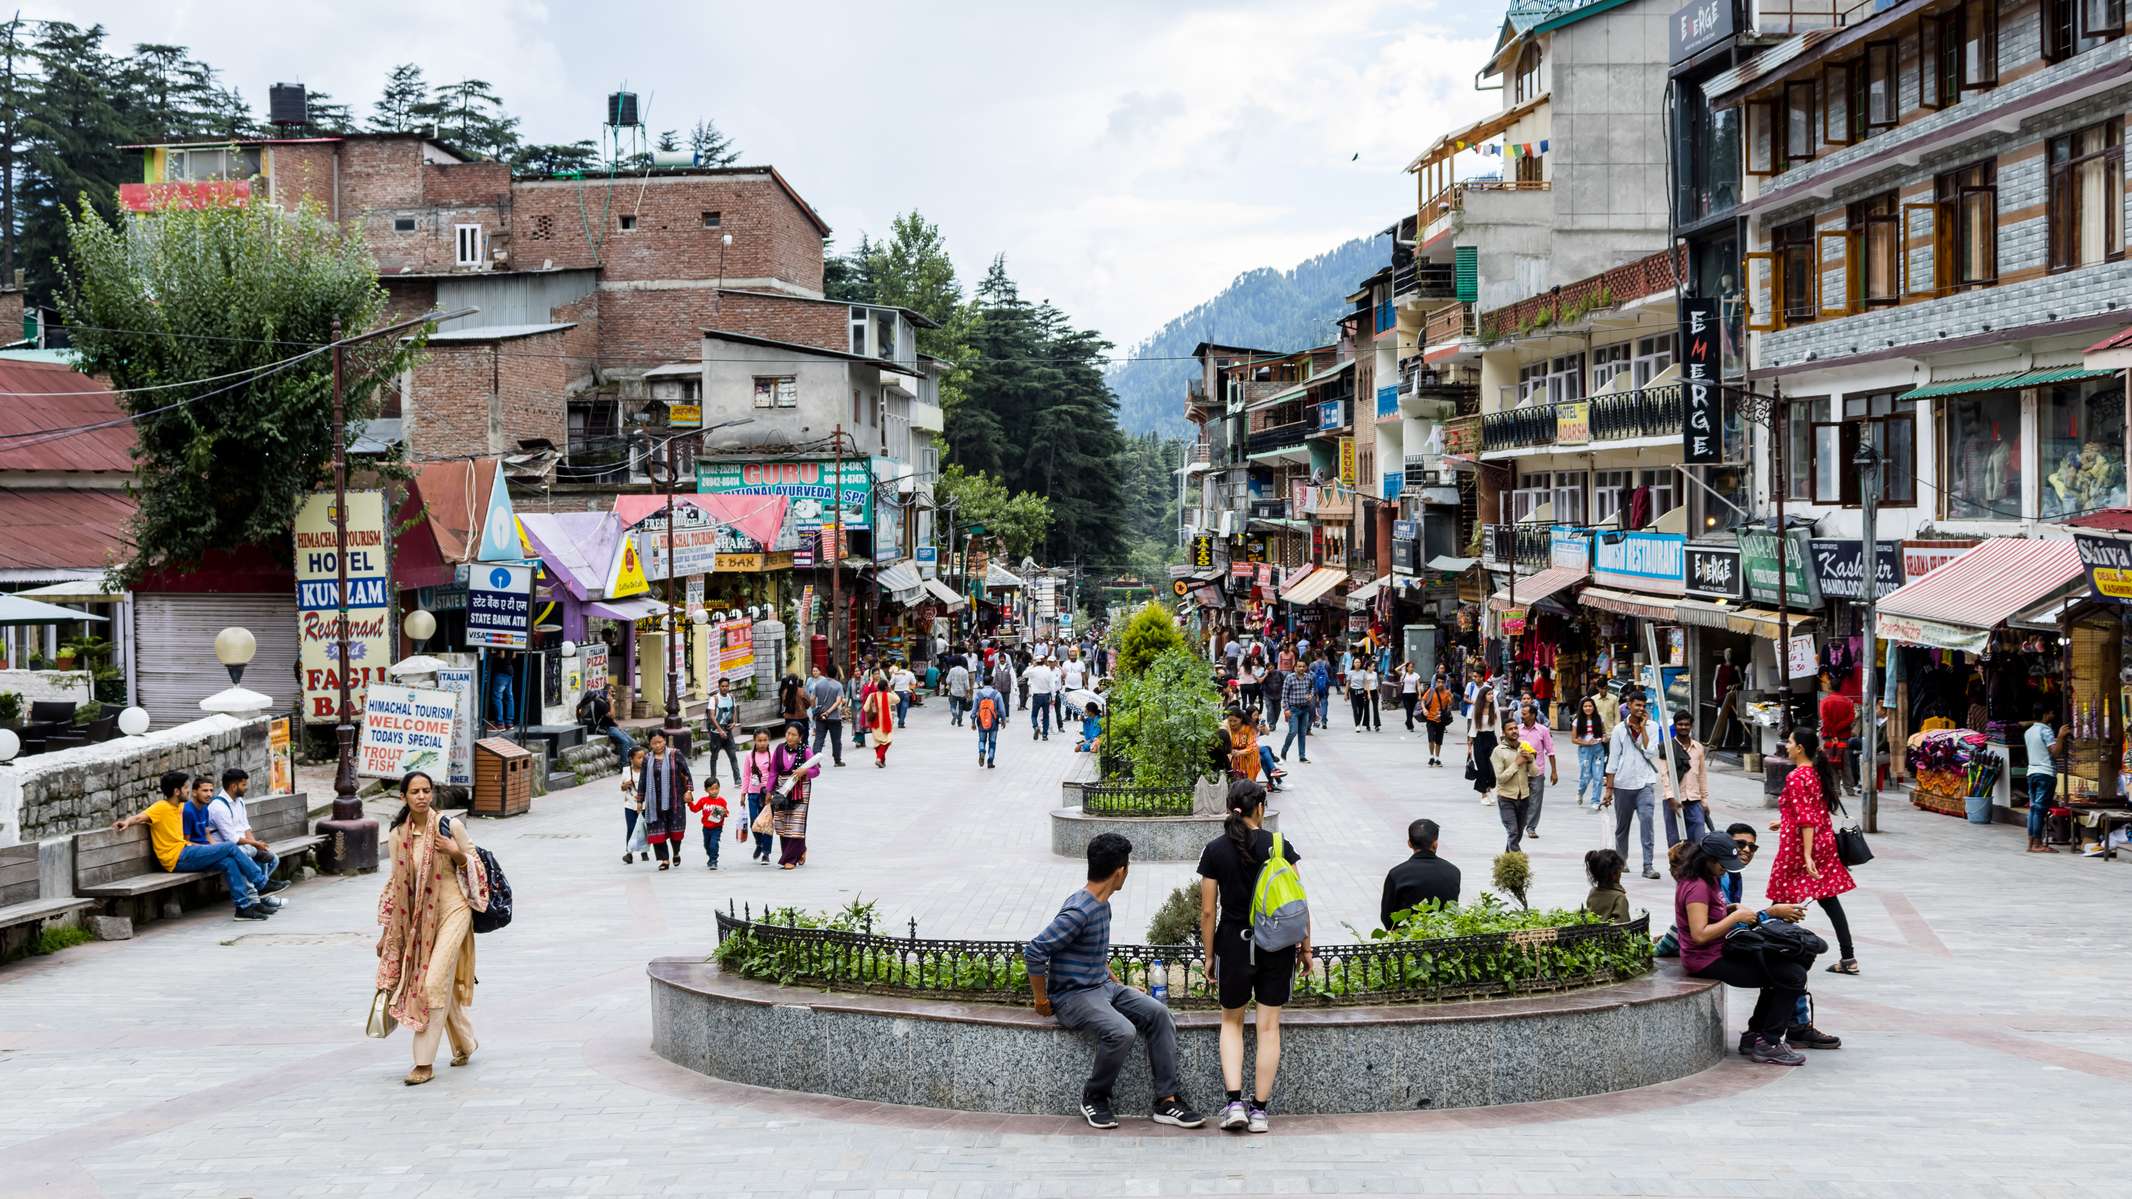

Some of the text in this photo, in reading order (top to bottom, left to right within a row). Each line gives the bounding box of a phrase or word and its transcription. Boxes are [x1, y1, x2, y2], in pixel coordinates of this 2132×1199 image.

[743, 463, 819, 485] GURU
[775, 485, 832, 498] AYURVEDA
[844, 490, 867, 505] SPA
[297, 531, 339, 548] HIMACHA
[308, 551, 374, 573] HOEL
[1626, 537, 1682, 576] RESTAURANT
[1818, 551, 1894, 579] Kashir
[1694, 553, 1732, 587] EMERGE
[437, 595, 460, 610] STATE
[470, 612, 527, 628] STATE BANK ATM
[468, 631, 486, 640] VISA
[587, 655, 608, 669] PIZZA
[439, 672, 470, 681] ITALIAN
[368, 699, 454, 720] HIMACHAL TOURISM
[368, 715, 449, 735] WELCOME
[371, 729, 443, 749] TODAYS SPECIAL
[363, 746, 405, 761] TROUT
[367, 759, 396, 773] FISH
